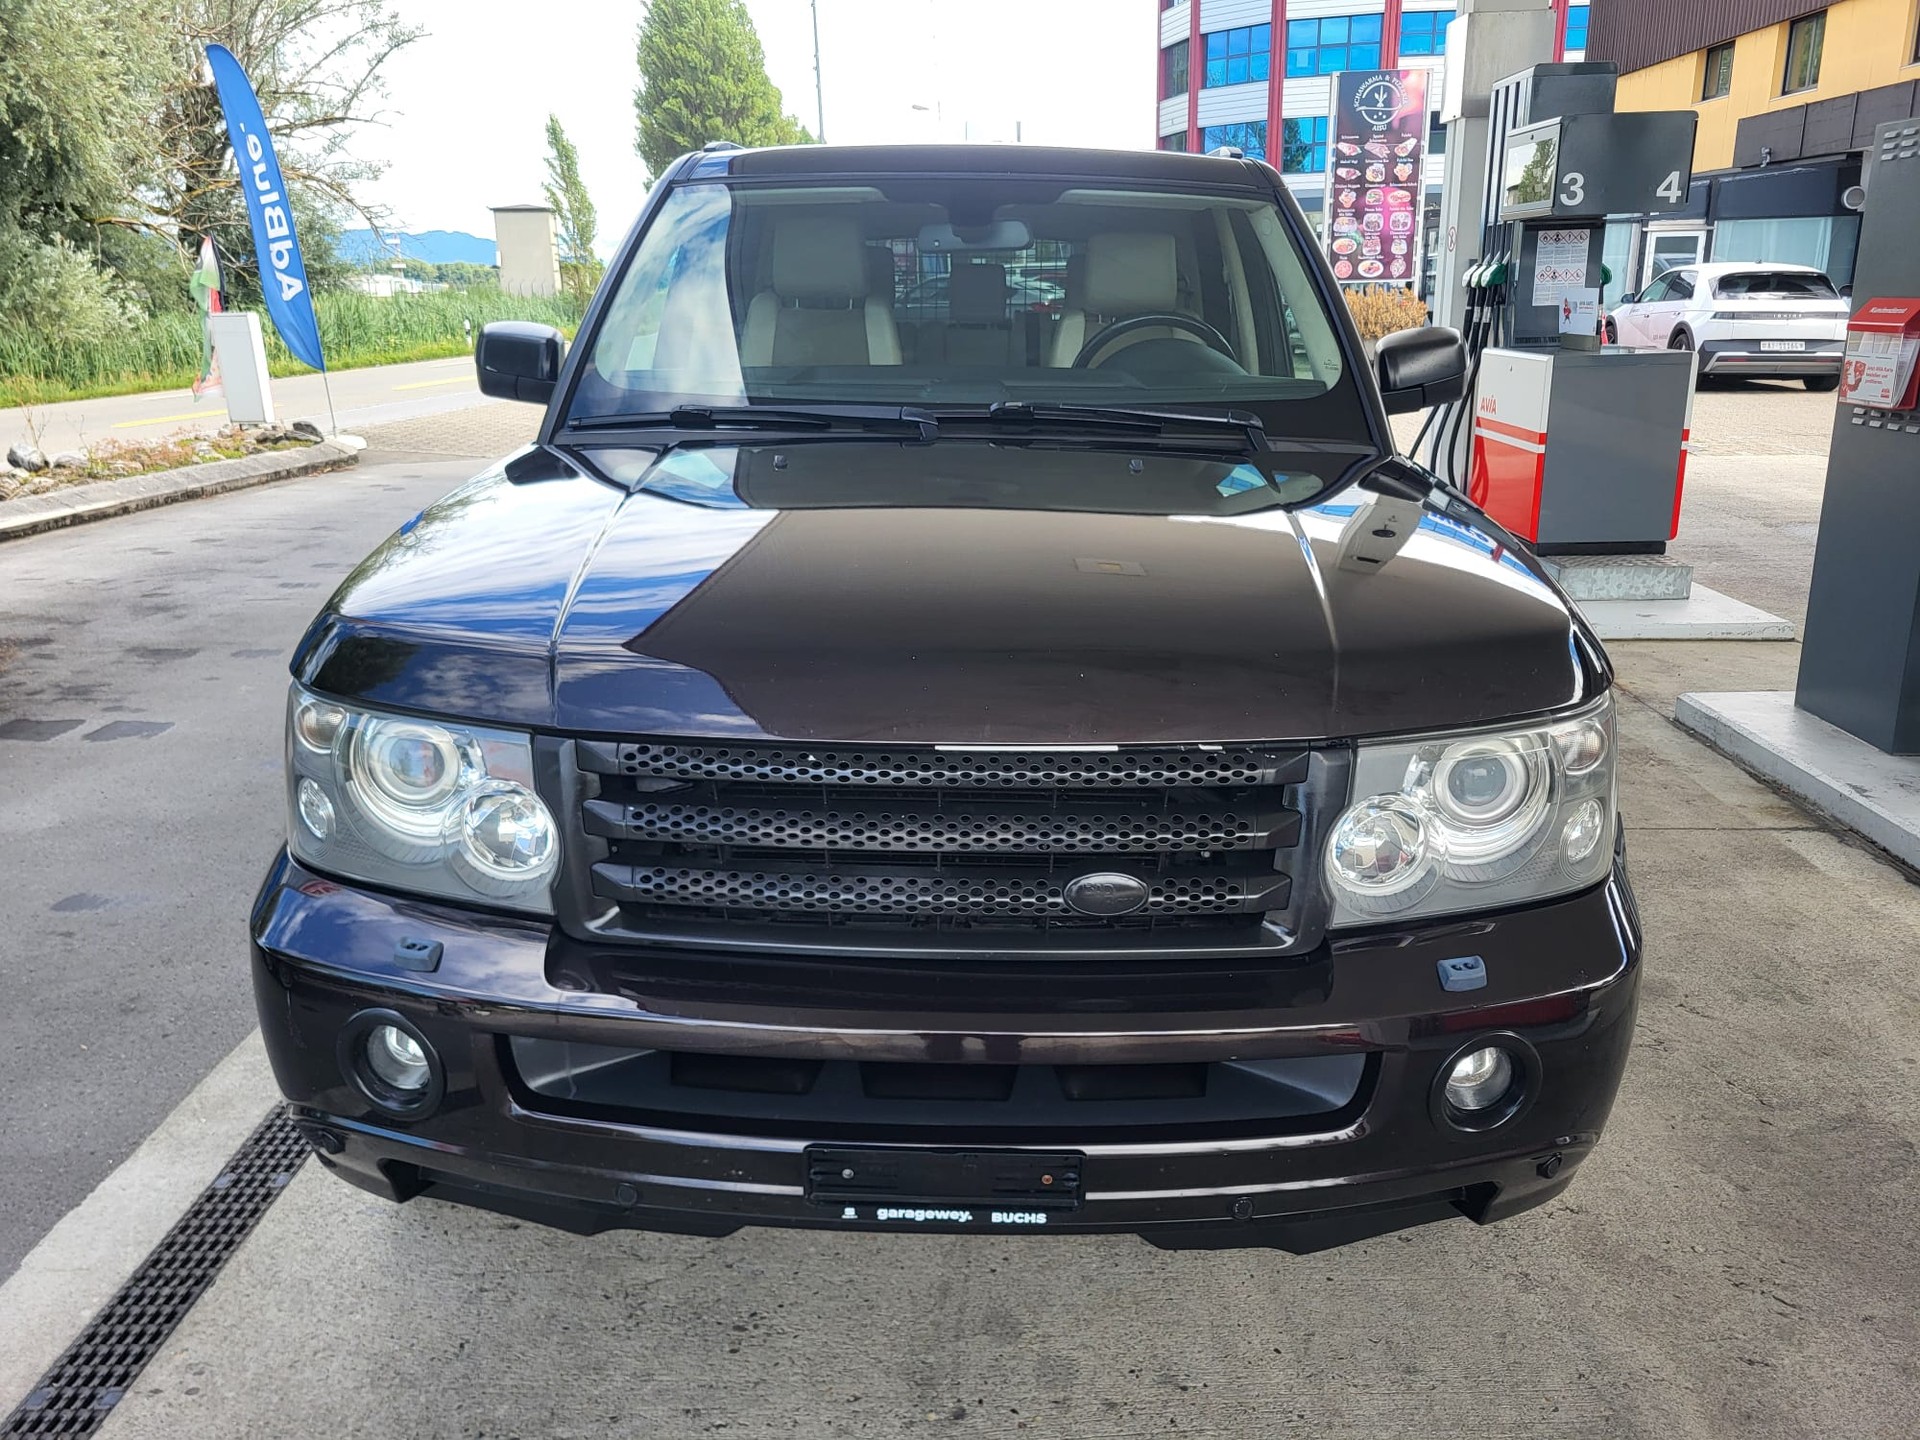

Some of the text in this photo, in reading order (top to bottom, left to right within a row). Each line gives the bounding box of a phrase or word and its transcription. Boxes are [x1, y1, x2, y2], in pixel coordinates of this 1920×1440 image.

[1559, 172, 1585, 206] 3
[1655, 170, 1682, 204] 4
[1480, 395, 1497, 415] AVIA
[991, 1211, 1048, 1224] BUCHS
